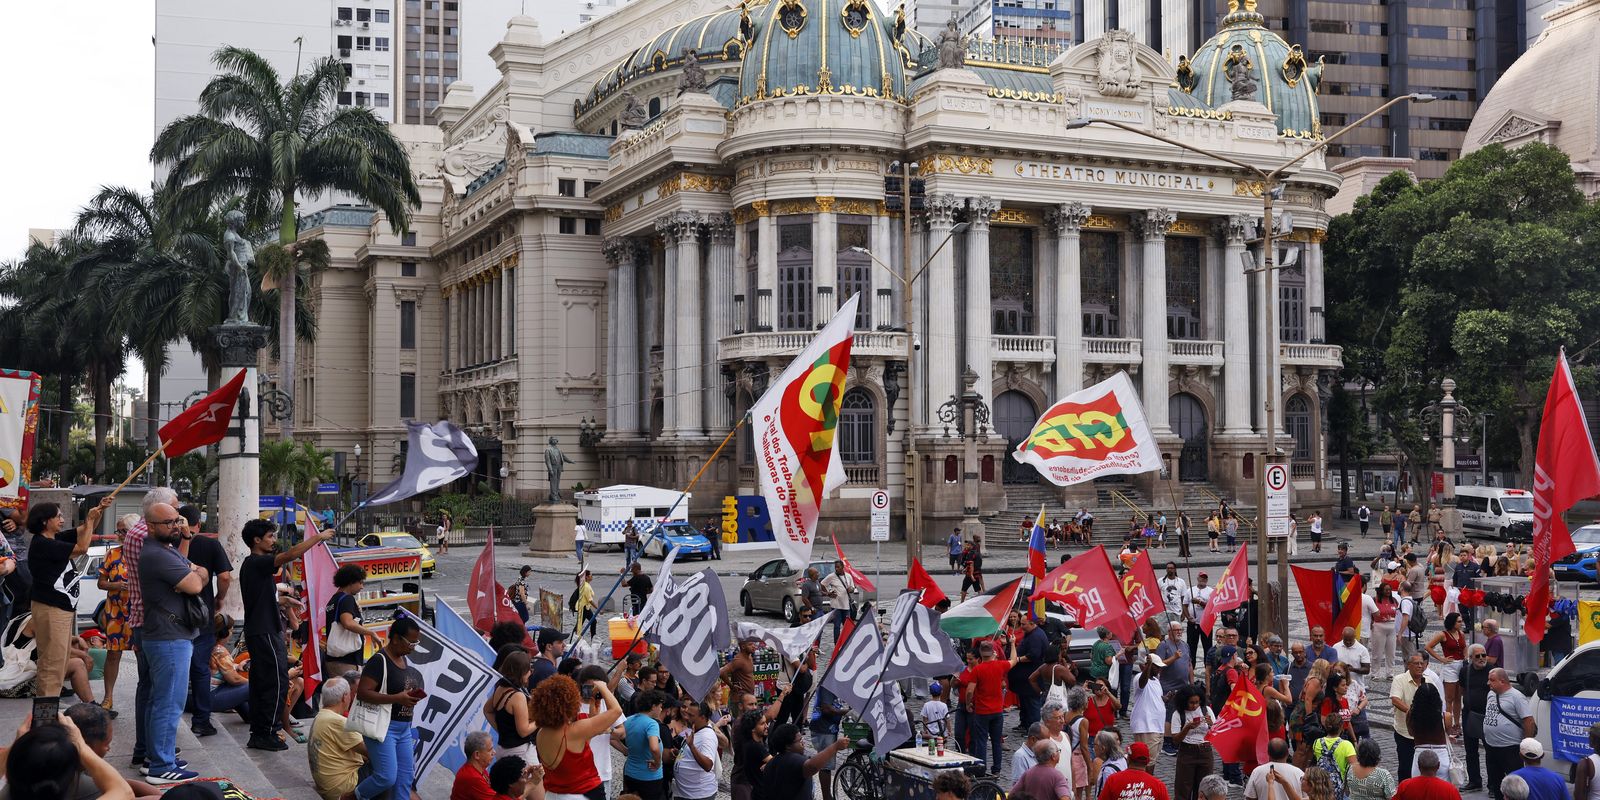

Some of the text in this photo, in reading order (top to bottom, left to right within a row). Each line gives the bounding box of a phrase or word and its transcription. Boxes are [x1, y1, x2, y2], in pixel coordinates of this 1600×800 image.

[1029, 164, 1204, 190] THEATRO MUNICIPAL
[1273, 471, 1280, 485] E
[778, 454, 809, 544] Trabalhadores
[877, 494, 883, 505] E
[775, 486, 786, 500] do
[782, 505, 799, 542] Brasil
[371, 561, 409, 575] SERVICE
